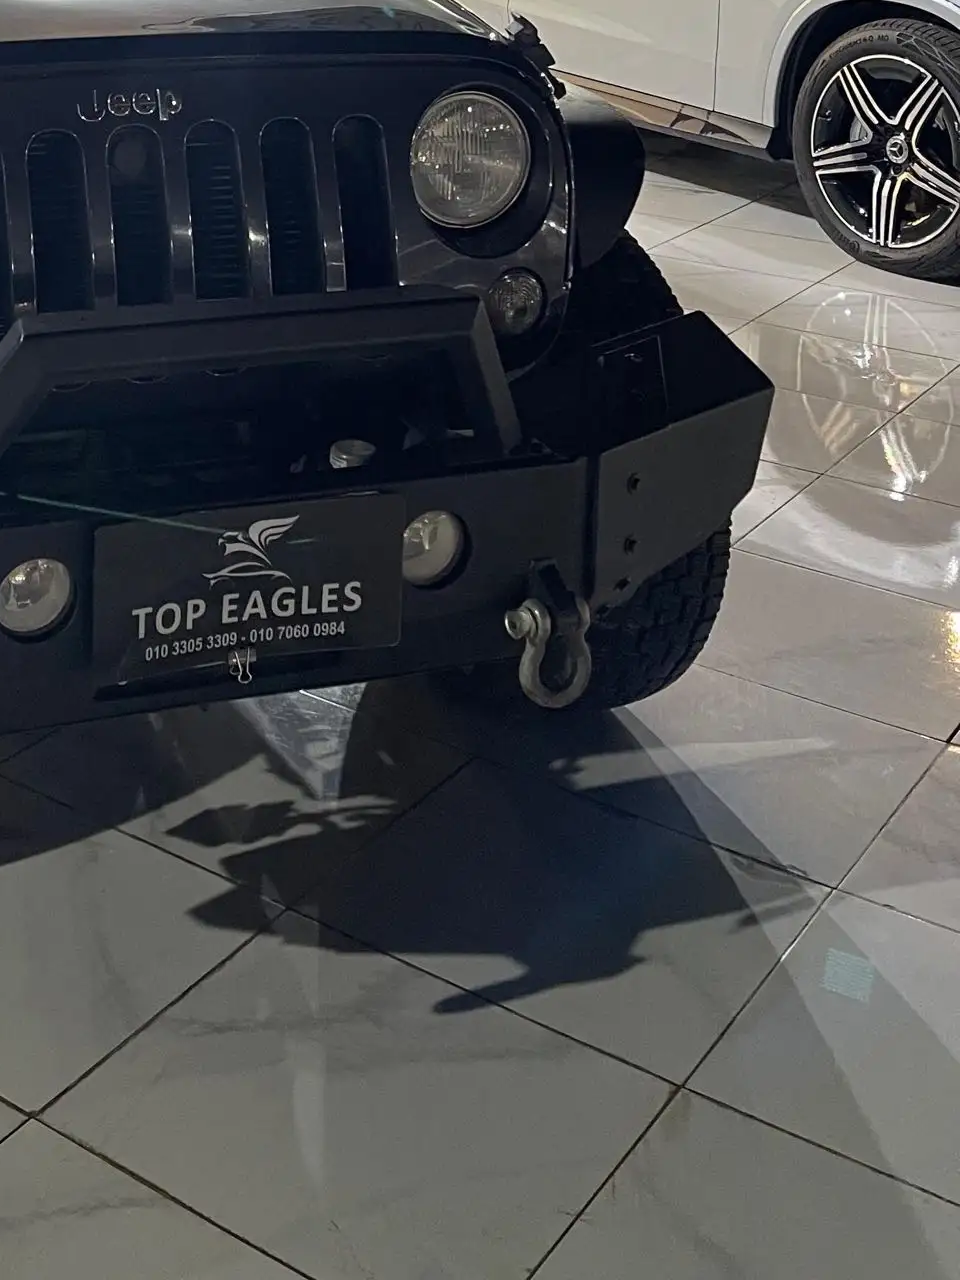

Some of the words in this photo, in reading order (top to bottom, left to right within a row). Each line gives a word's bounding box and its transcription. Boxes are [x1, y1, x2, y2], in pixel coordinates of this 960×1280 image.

[76, 88, 183, 122] Jeep
[131, 598, 206, 639] TOP
[221, 581, 362, 625] EAGLES
[145, 643, 168, 661] 010
[171, 637, 203, 655] 3305
[206, 631, 237, 649] 3309
[249, 628, 274, 643] 010
[277, 624, 309, 639] 7060
[313, 620, 345, 636] 0984
